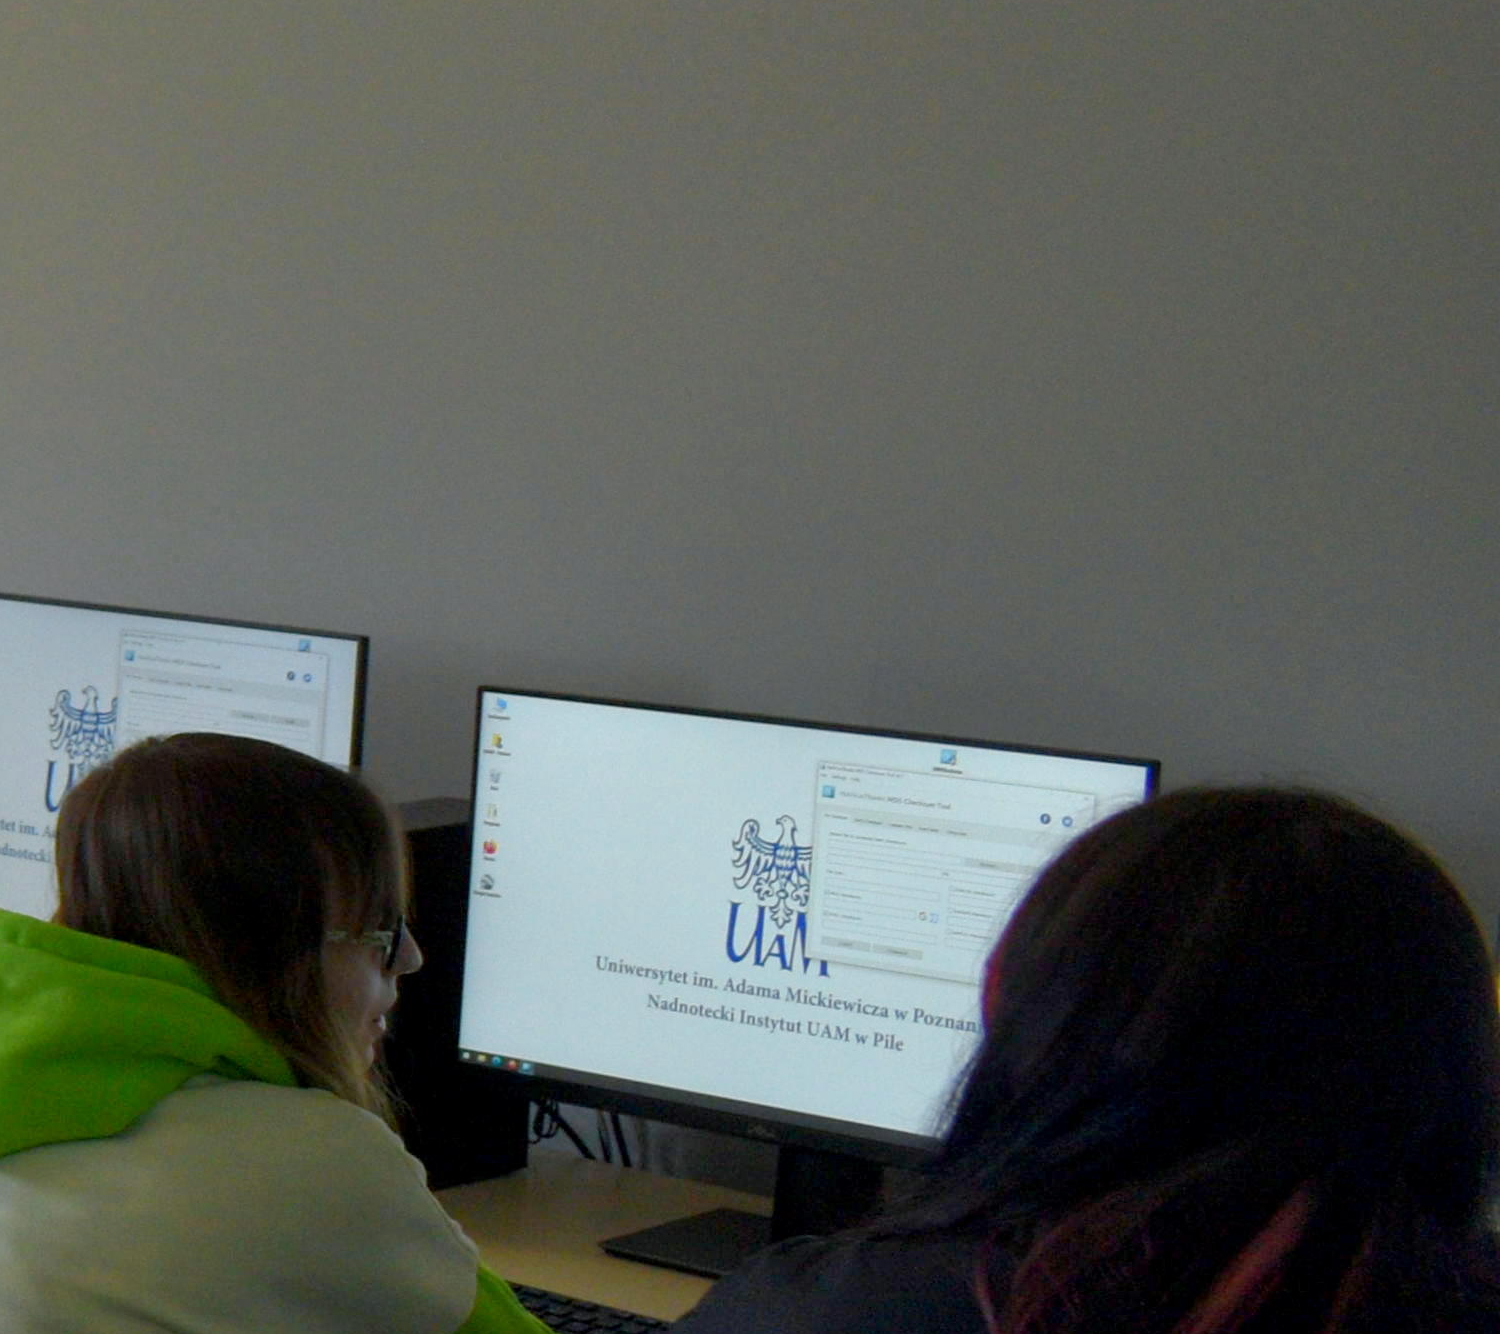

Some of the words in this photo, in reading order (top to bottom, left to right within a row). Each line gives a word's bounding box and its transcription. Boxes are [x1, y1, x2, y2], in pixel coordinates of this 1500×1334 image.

[725, 899, 831, 979] UAM
[595, 954, 689, 986] Uniwersytet
[691, 970, 719, 990] im.
[722, 976, 782, 1001] Adama
[784, 985, 890, 1019] Mickiewicza
[893, 1008, 910, 1023] w
[912, 1006, 981, 1034] Poznan
[646, 993, 736, 1023] Nadnotecki
[739, 1008, 802, 1035] Instytut
[806, 1020, 851, 1043] UAM
[854, 1031, 870, 1046] w
[872, 1031, 905, 1052] Pile
